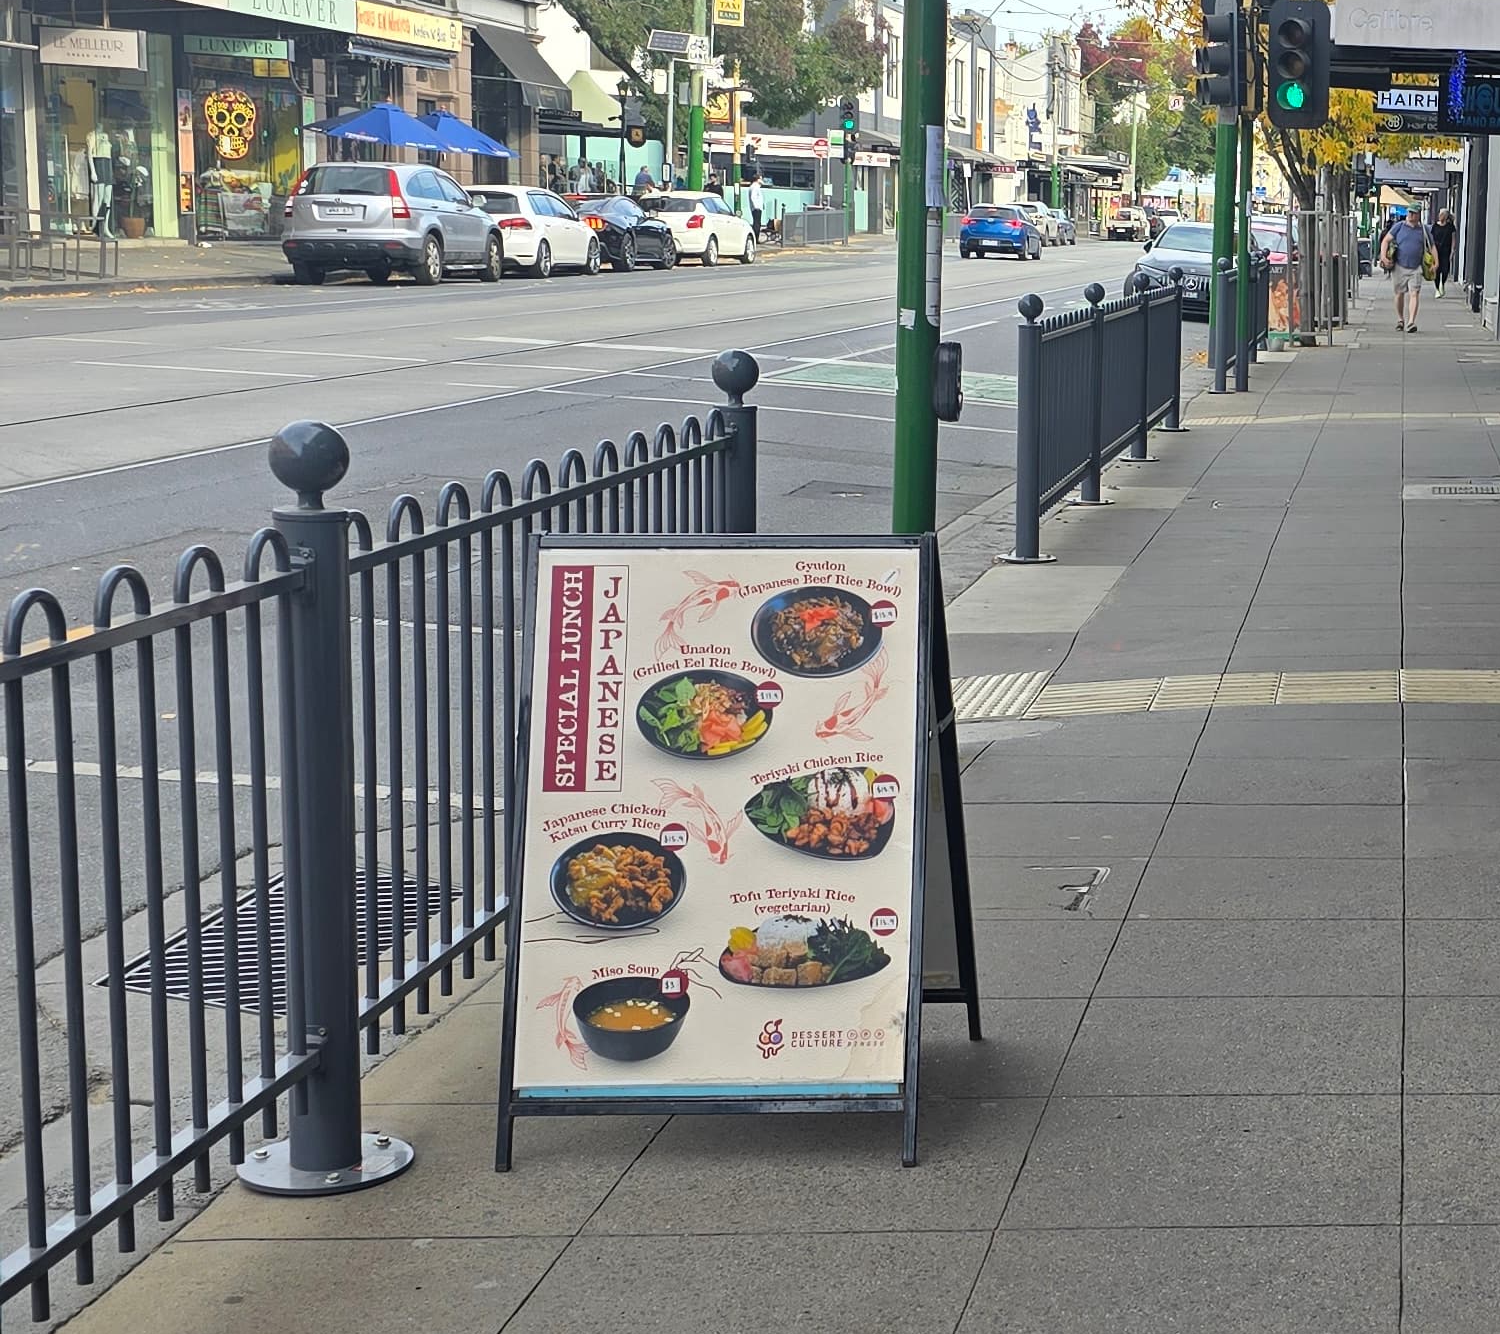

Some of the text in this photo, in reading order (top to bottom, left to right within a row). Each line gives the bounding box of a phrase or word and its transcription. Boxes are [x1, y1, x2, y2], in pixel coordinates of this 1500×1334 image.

[719, 1, 740, 9] TAXI
[719, 11, 739, 20] RANK
[54, 35, 125, 52] LE MEILLEUR
[199, 38, 274, 55] LUXEVER
[795, 560, 846, 573] Gyudon
[738, 574, 902, 600] (Japanese Beef Rice Bowl)
[680, 643, 731, 655] Unadon
[632, 657, 777, 681] (Grilled Eel Rice Bowl)
[555, 570, 583, 787] SPECIAL LUNCH
[594, 576, 626, 782] JAPANESE
[751, 752, 884, 786] Teriyaki Chicken Rice
[542, 803, 667, 833] Japanese Chicken
[548, 817, 662, 844] Katsu Curry Rice
[729, 887, 856, 905] Tofu Teriyaki Rice
[754, 902, 831, 916] (vegetarian)
[591, 963, 660, 980] Miso Soup
[791, 1030, 844, 1040] DESSERT
[791, 1039, 843, 1048] CULTURE
